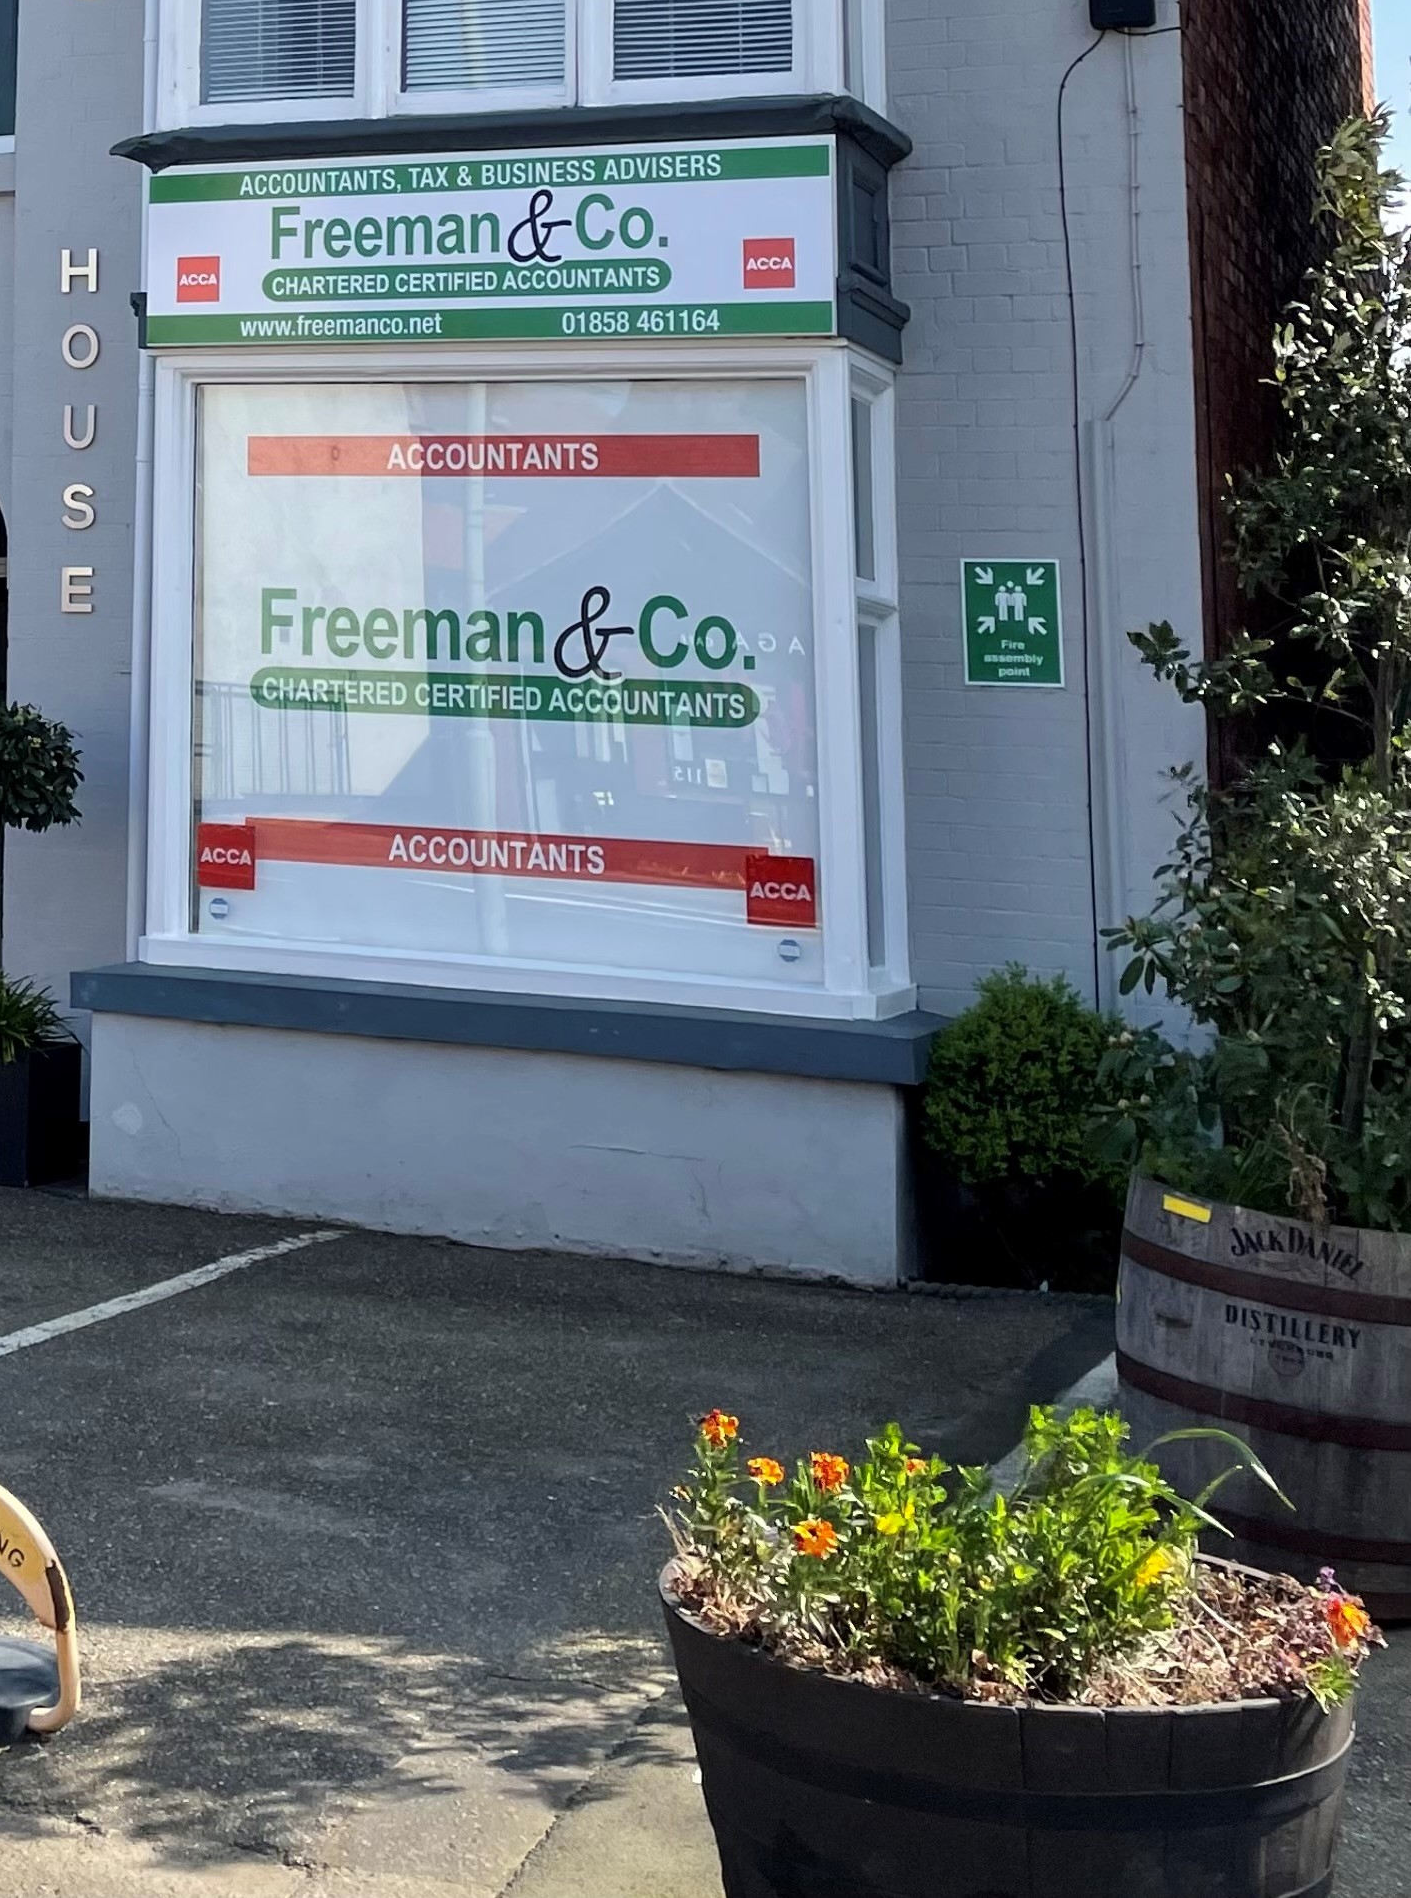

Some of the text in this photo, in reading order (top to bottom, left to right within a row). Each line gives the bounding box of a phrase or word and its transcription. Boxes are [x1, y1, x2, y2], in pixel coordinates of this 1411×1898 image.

[239, 153, 722, 196] ACCOUNTANTS, TAX & BUSINESS ADVISERS
[271, 188, 669, 263] Freeman & Co.
[746, 256, 793, 271] ACCA
[178, 273, 218, 287] ACCA
[272, 266, 661, 297] CHARTERED CERTIFIED ACCOUNTANTS
[239, 308, 720, 338] www.freemanco.net 01858 461164
[60, 247, 100, 614] HOUSE
[387, 442, 600, 472] ACCOUNTANTS
[260, 585, 757, 681] Freeman & Co.
[1000, 639, 1026, 651] Fire
[983, 653, 1044, 667] assembly
[998, 666, 1031, 678] point
[262, 676, 746, 720] CHARTERED CERTIFIED ACCOUNTANTS
[200, 846, 253, 868] ACCA
[388, 834, 606, 875] ACCOUNTANTS
[750, 881, 812, 902] ACCA
[1230, 1227, 1285, 1257] JACK
[1224, 1302, 1362, 1350] DISTILLERY
